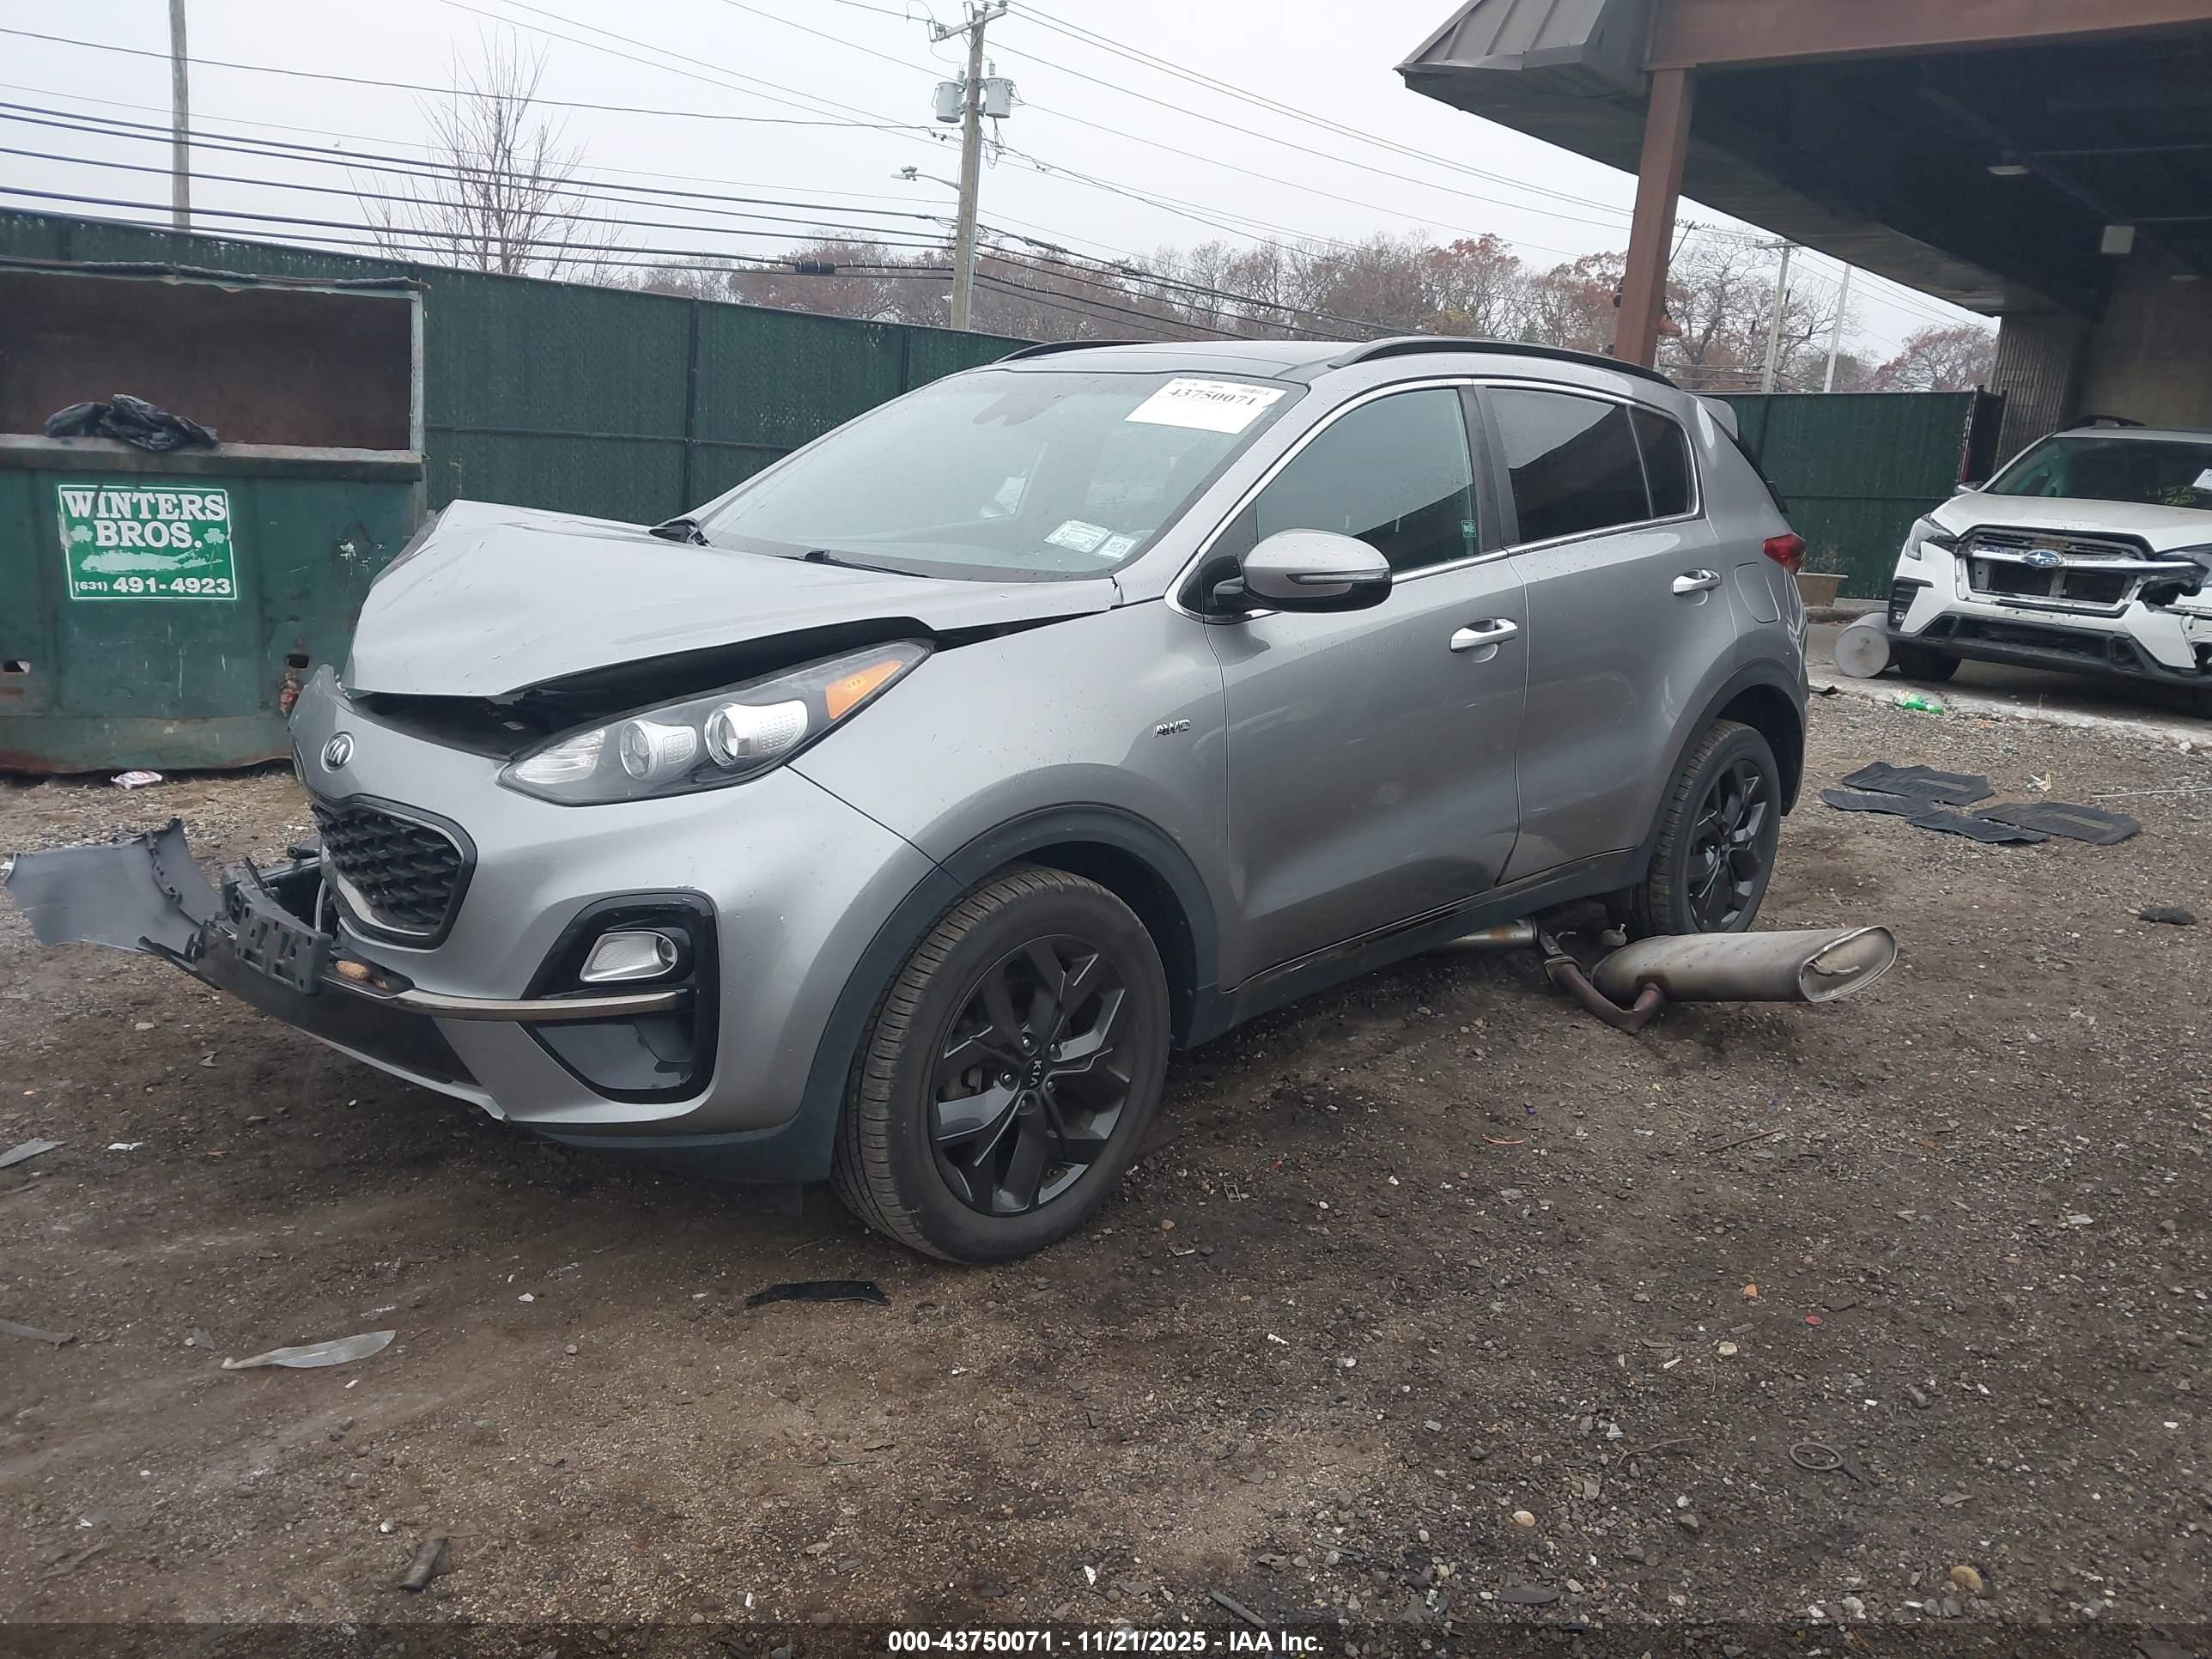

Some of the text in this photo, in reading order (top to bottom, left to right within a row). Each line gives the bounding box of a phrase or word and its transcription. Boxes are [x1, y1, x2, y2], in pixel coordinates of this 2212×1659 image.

[1169, 388, 1257, 405] 43750071
[62, 490, 226, 521] WINTERS
[93, 520, 202, 548] BROS.
[76, 576, 231, 593] (631) 491-4923
[1153, 719, 1191, 738] AWD
[1029, 1060, 1042, 1086] KIA
